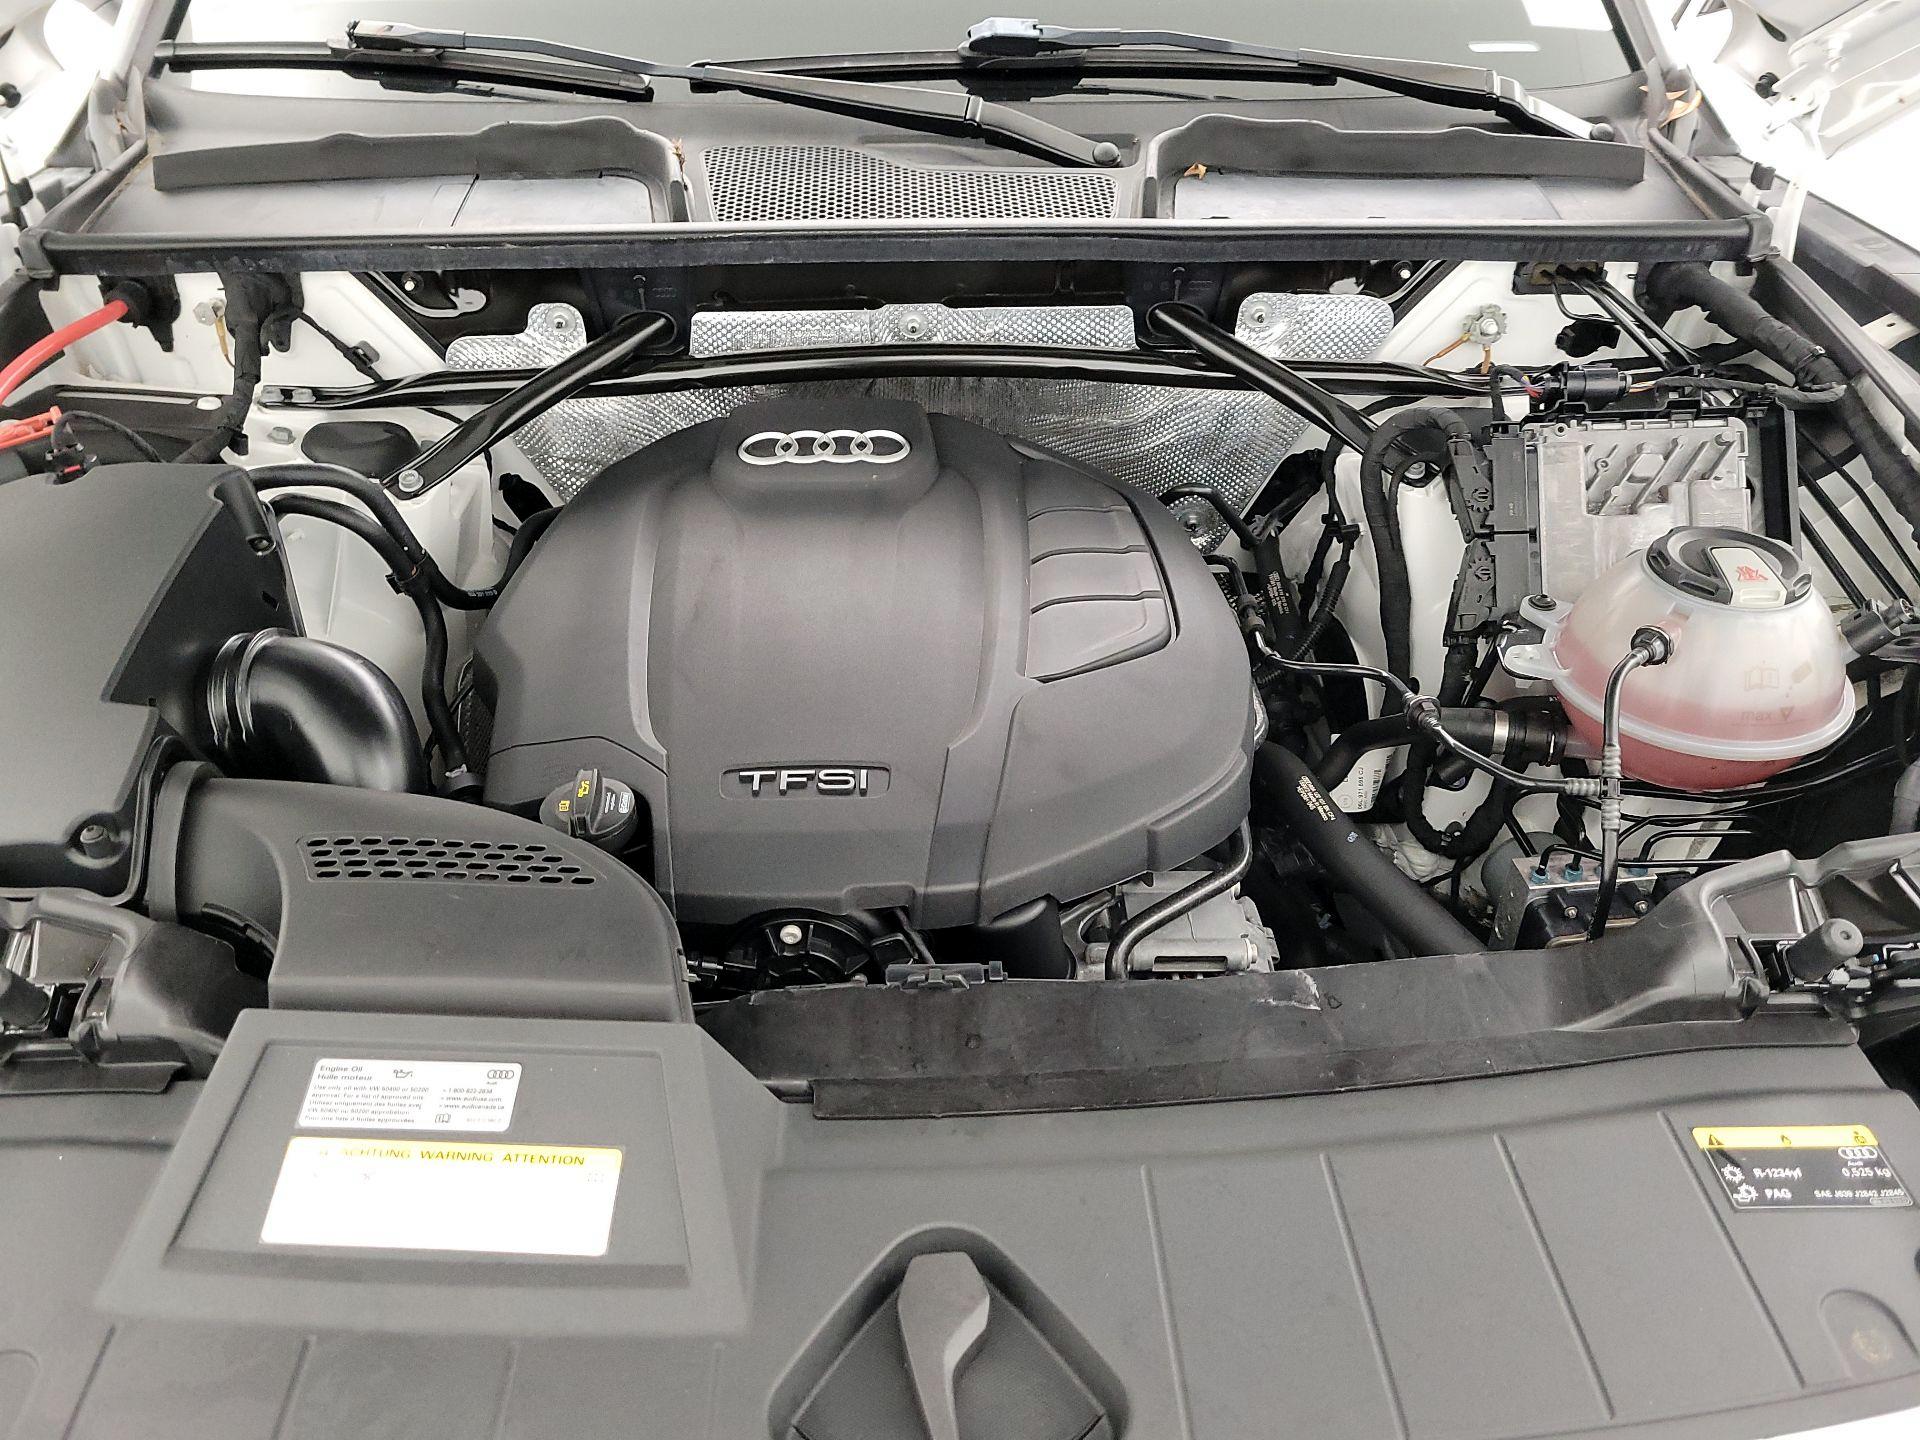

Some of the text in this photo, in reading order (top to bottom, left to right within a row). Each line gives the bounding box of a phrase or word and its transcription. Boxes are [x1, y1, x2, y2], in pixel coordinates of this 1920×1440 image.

[738, 768, 870, 797] TFSI
[420, 1150, 493, 1163] WARNING
[502, 1152, 585, 1166] ATTENTION
[1841, 1167, 1874, 1178] 0,525
[1874, 1167, 1892, 1178] kg
[1764, 1188, 1792, 1199] PAG
